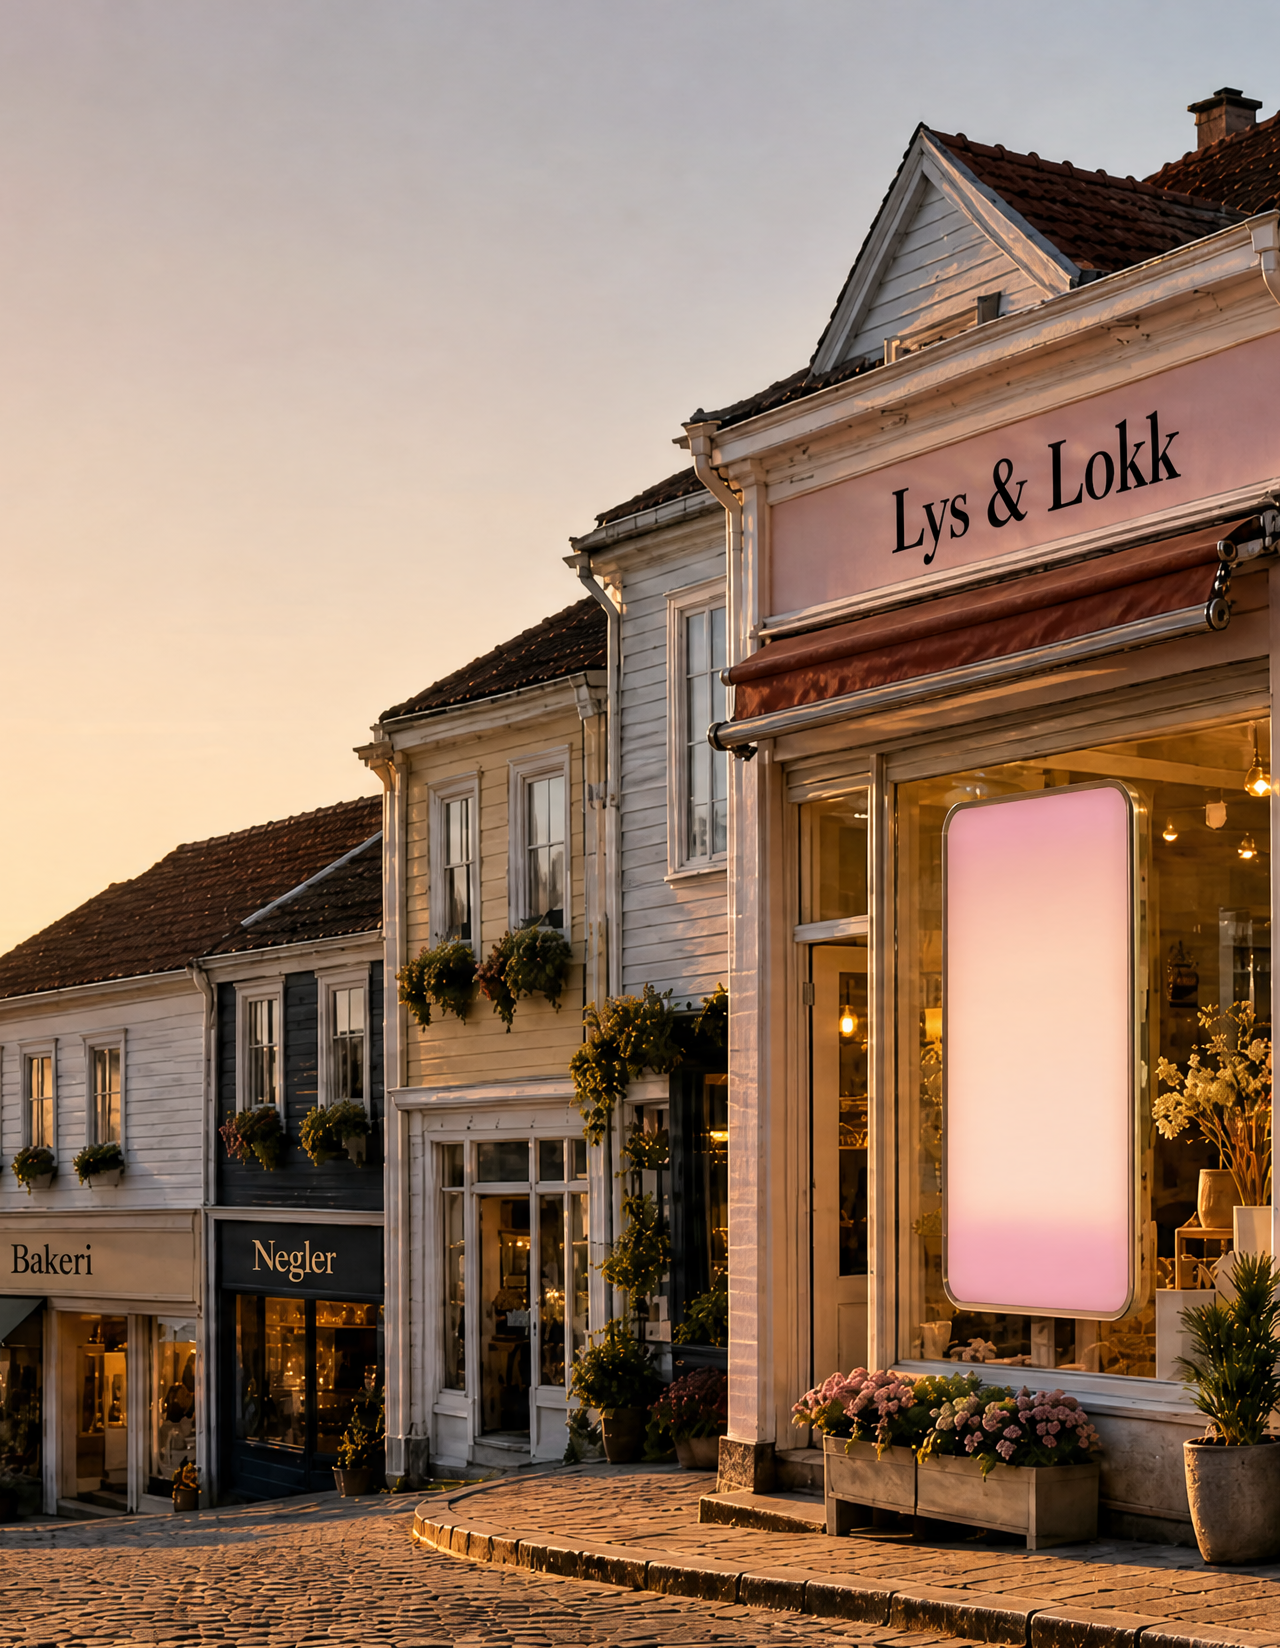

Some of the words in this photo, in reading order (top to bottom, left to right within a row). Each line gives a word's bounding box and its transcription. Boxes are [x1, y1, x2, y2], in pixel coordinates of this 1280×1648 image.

[891, 486, 970, 566] Lys
[987, 457, 1028, 529] &
[1046, 409, 1182, 512] Lokk
[10, 1243, 94, 1276] Bakeri
[251, 1239, 338, 1283] Negler
